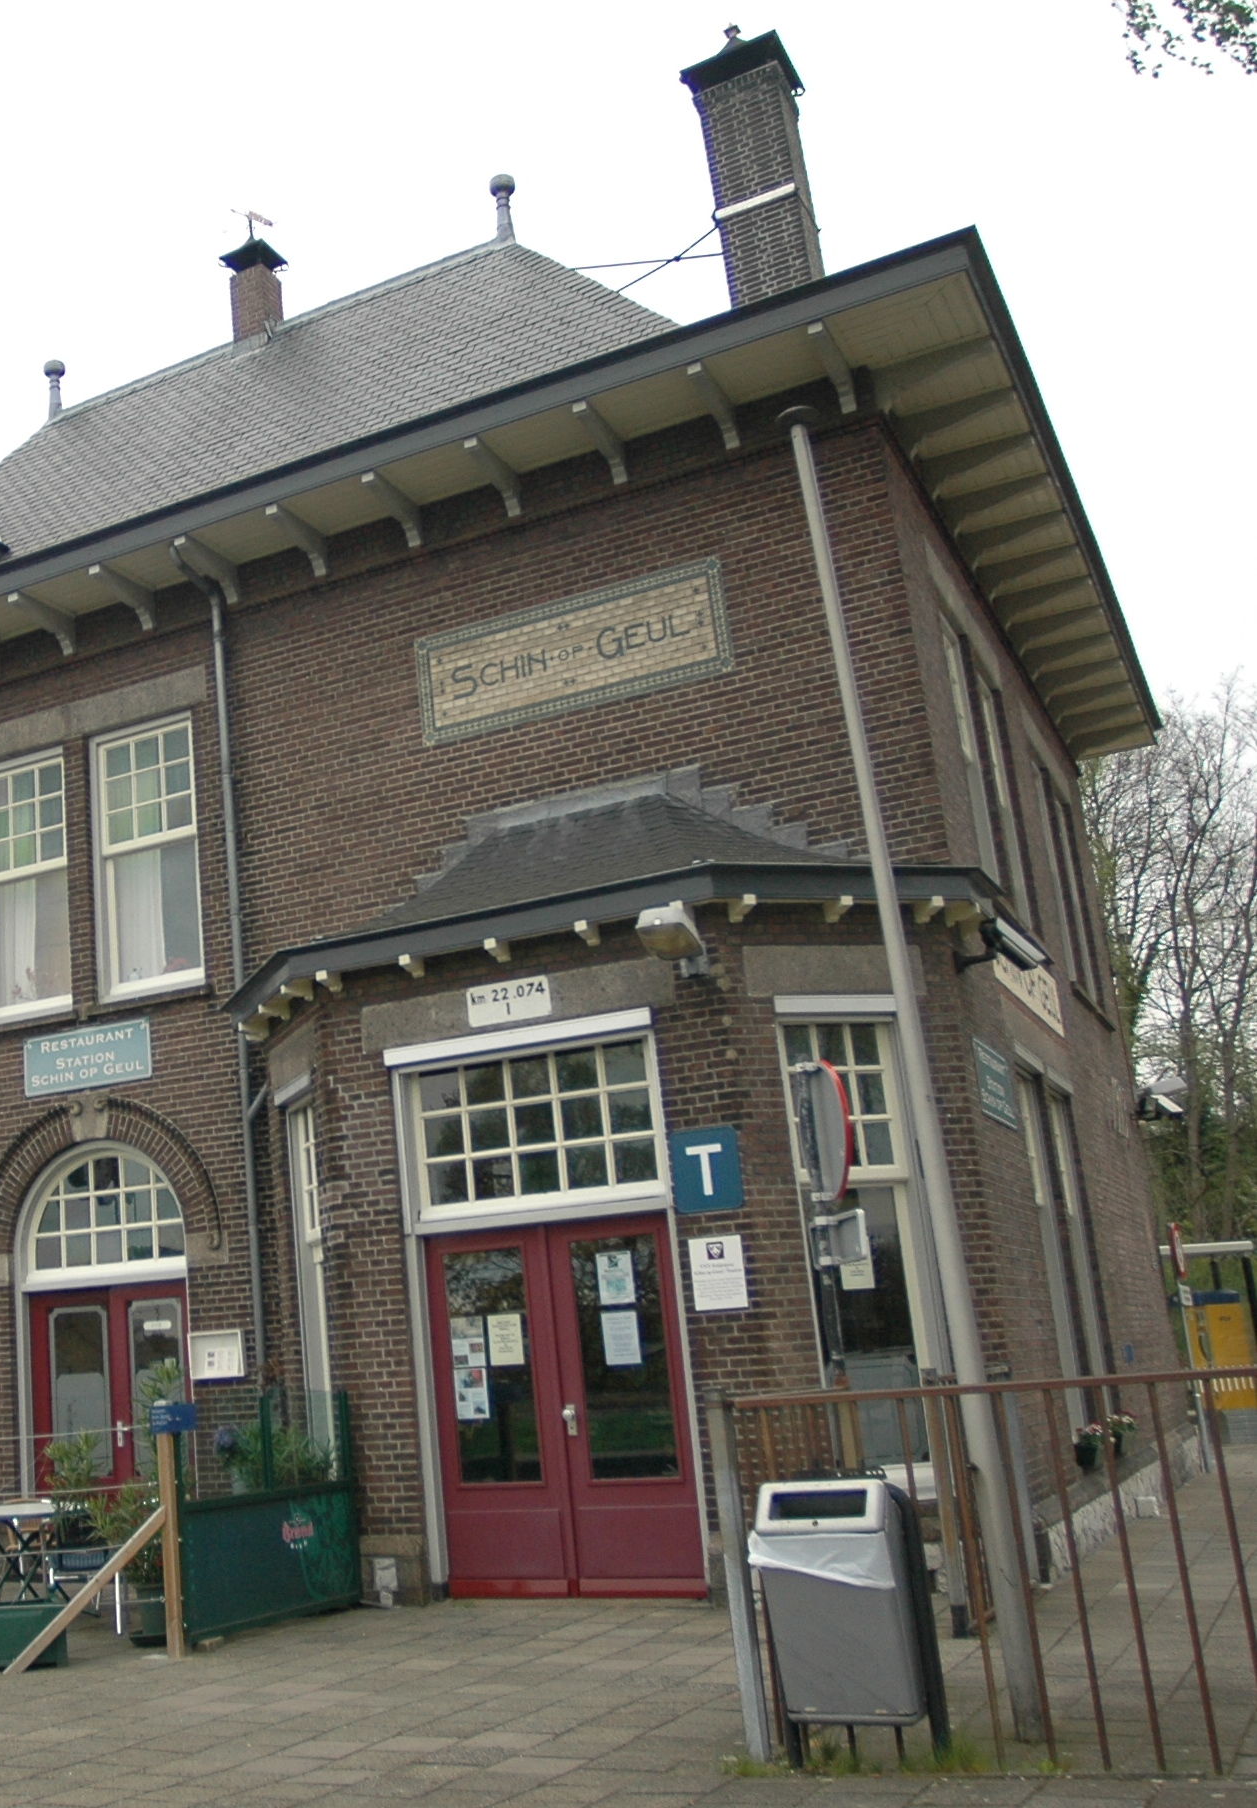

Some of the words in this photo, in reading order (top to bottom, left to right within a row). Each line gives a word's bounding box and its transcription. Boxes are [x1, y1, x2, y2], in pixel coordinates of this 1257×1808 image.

[470, 993, 486, 1005] km
[40, 1028, 133, 1054] RESTAURANT
[55, 1050, 115, 1070] STATION
[31, 1071, 74, 1087] SCHIN
[79, 1067, 98, 1079] OP
[103, 1060, 144, 1075] GEUL
[685, 1143, 723, 1196] T
